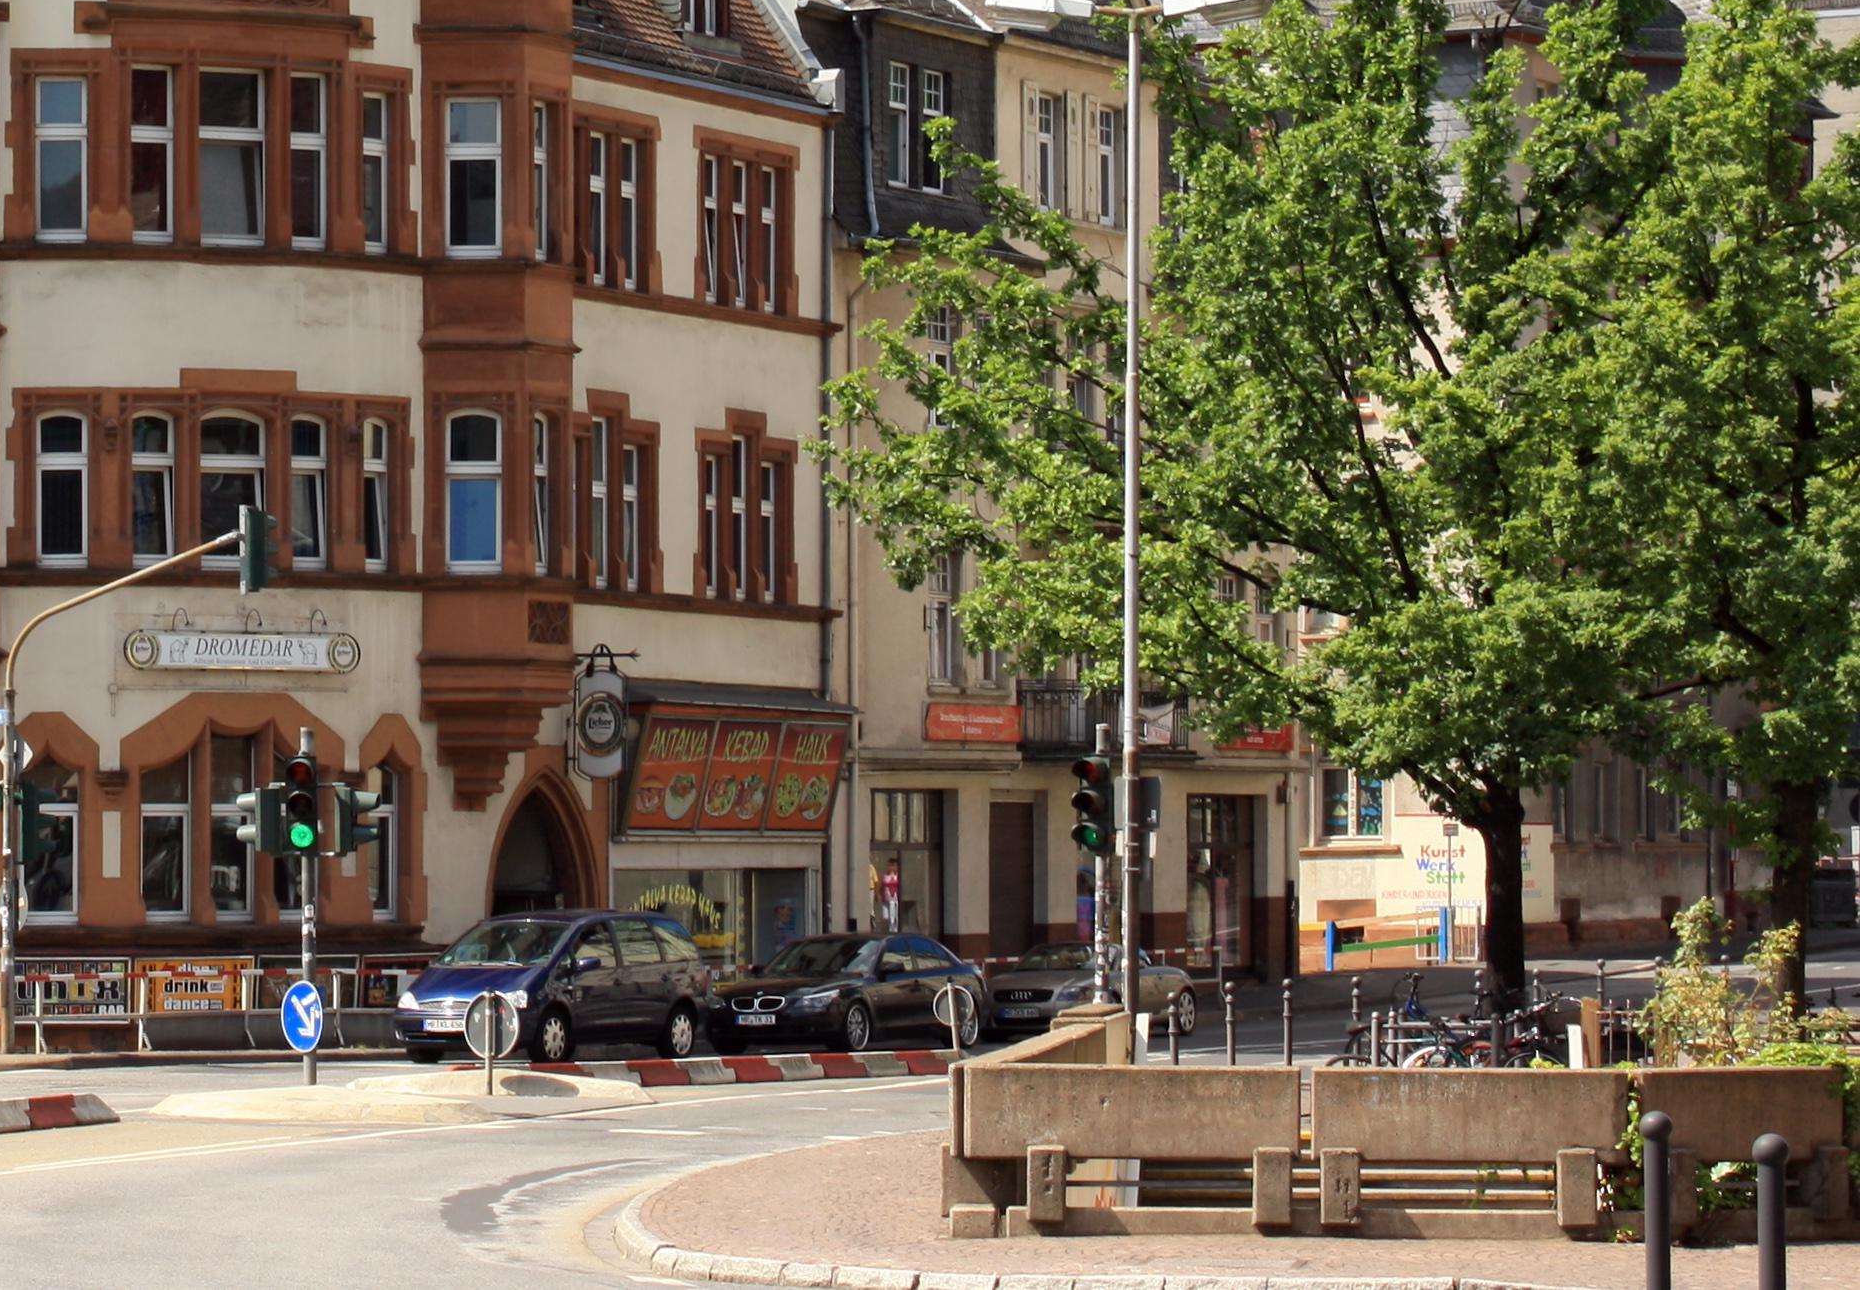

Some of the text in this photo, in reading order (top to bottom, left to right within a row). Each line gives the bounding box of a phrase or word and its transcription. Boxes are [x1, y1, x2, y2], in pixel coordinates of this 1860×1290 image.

[195, 637, 294, 657] DROMEDAR
[647, 726, 832, 765] ANTALYA KEBAP HAUS
[164, 979, 208, 994] drink
[164, 998, 209, 1010] dance
